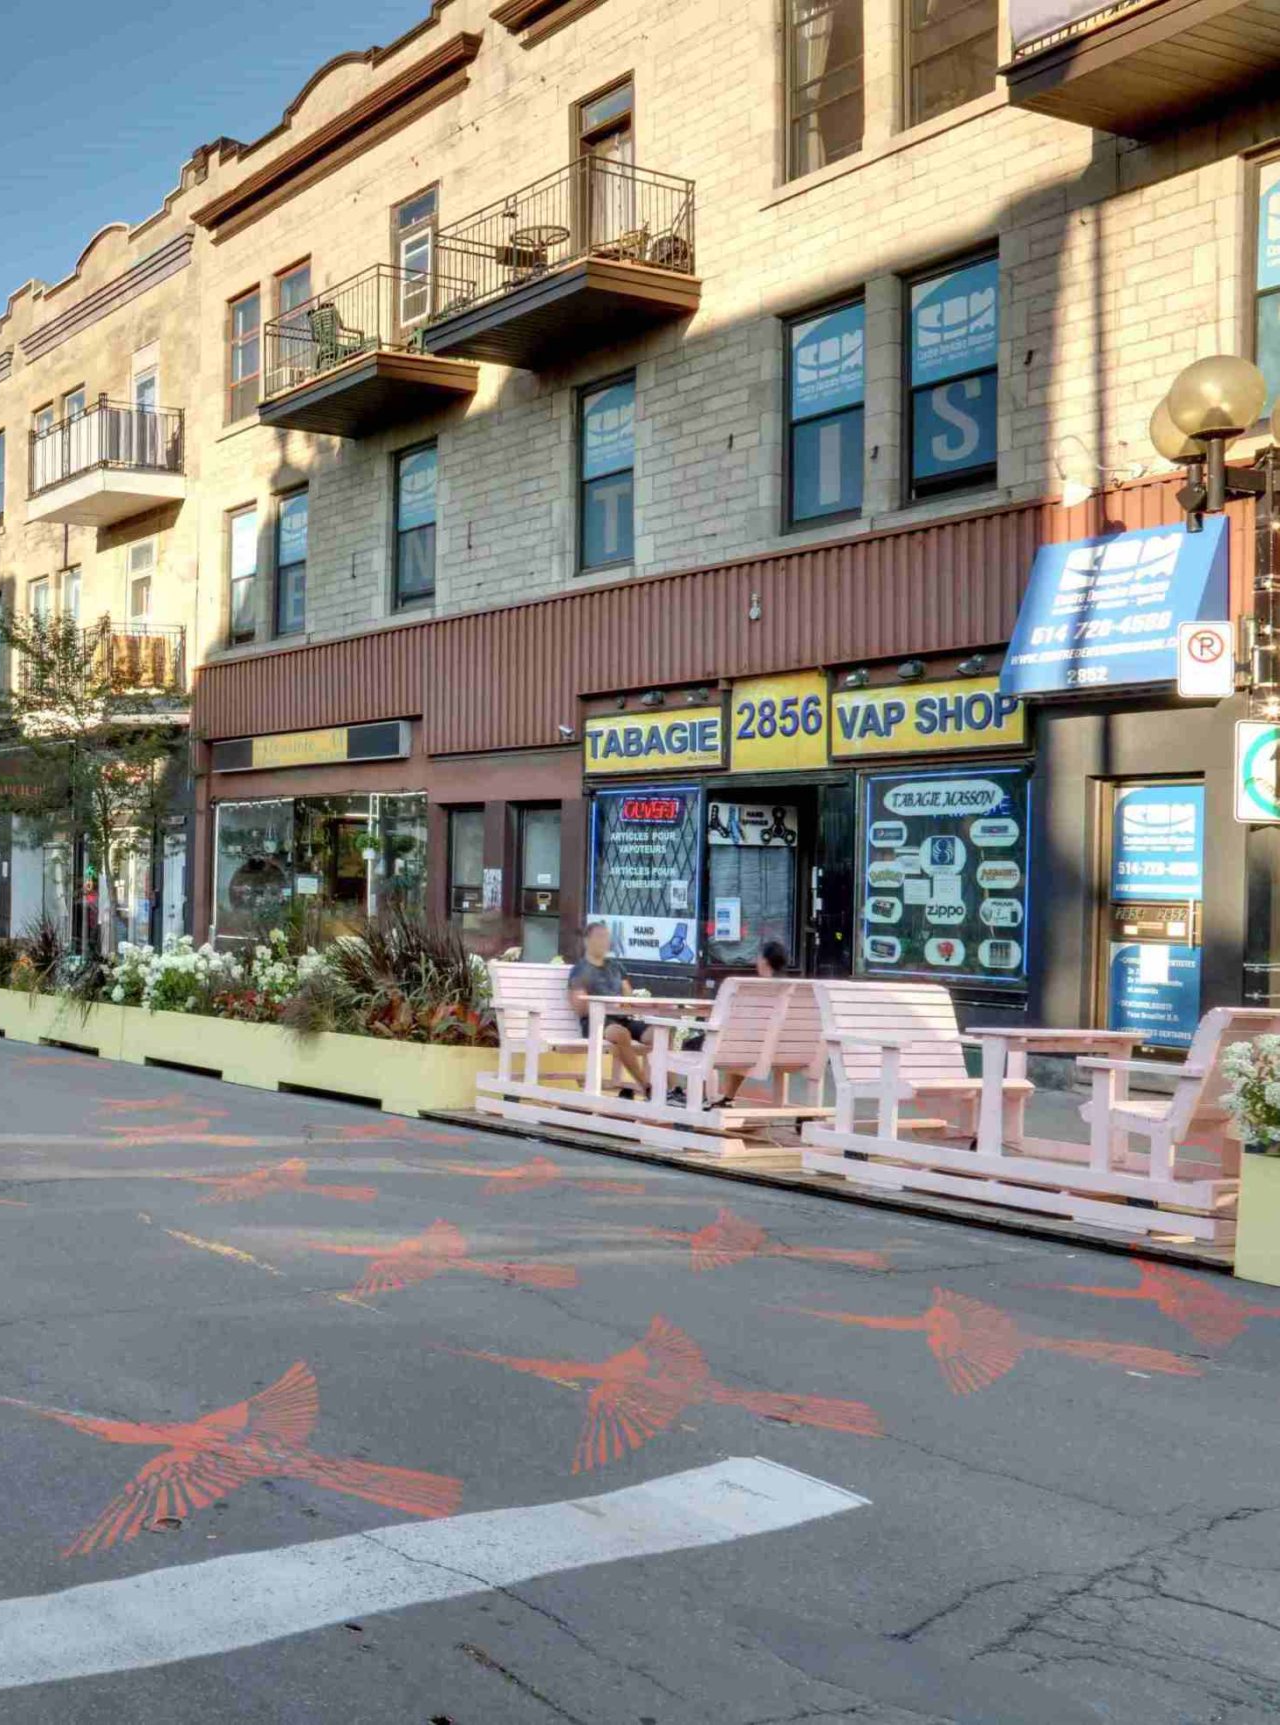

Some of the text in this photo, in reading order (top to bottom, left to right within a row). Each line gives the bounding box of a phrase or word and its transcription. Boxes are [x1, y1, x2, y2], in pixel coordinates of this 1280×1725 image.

[736, 694, 822, 740] 2856
[836, 692, 1018, 740] VAP SHOP
[586, 718, 719, 760] TABAGIE
[892, 791, 942, 809] TABAGIE
[942, 789, 996, 808] MASSON
[610, 832, 649, 842] ARTICLES
[927, 904, 964, 918] zippo
[634, 926, 654, 935] HAND
